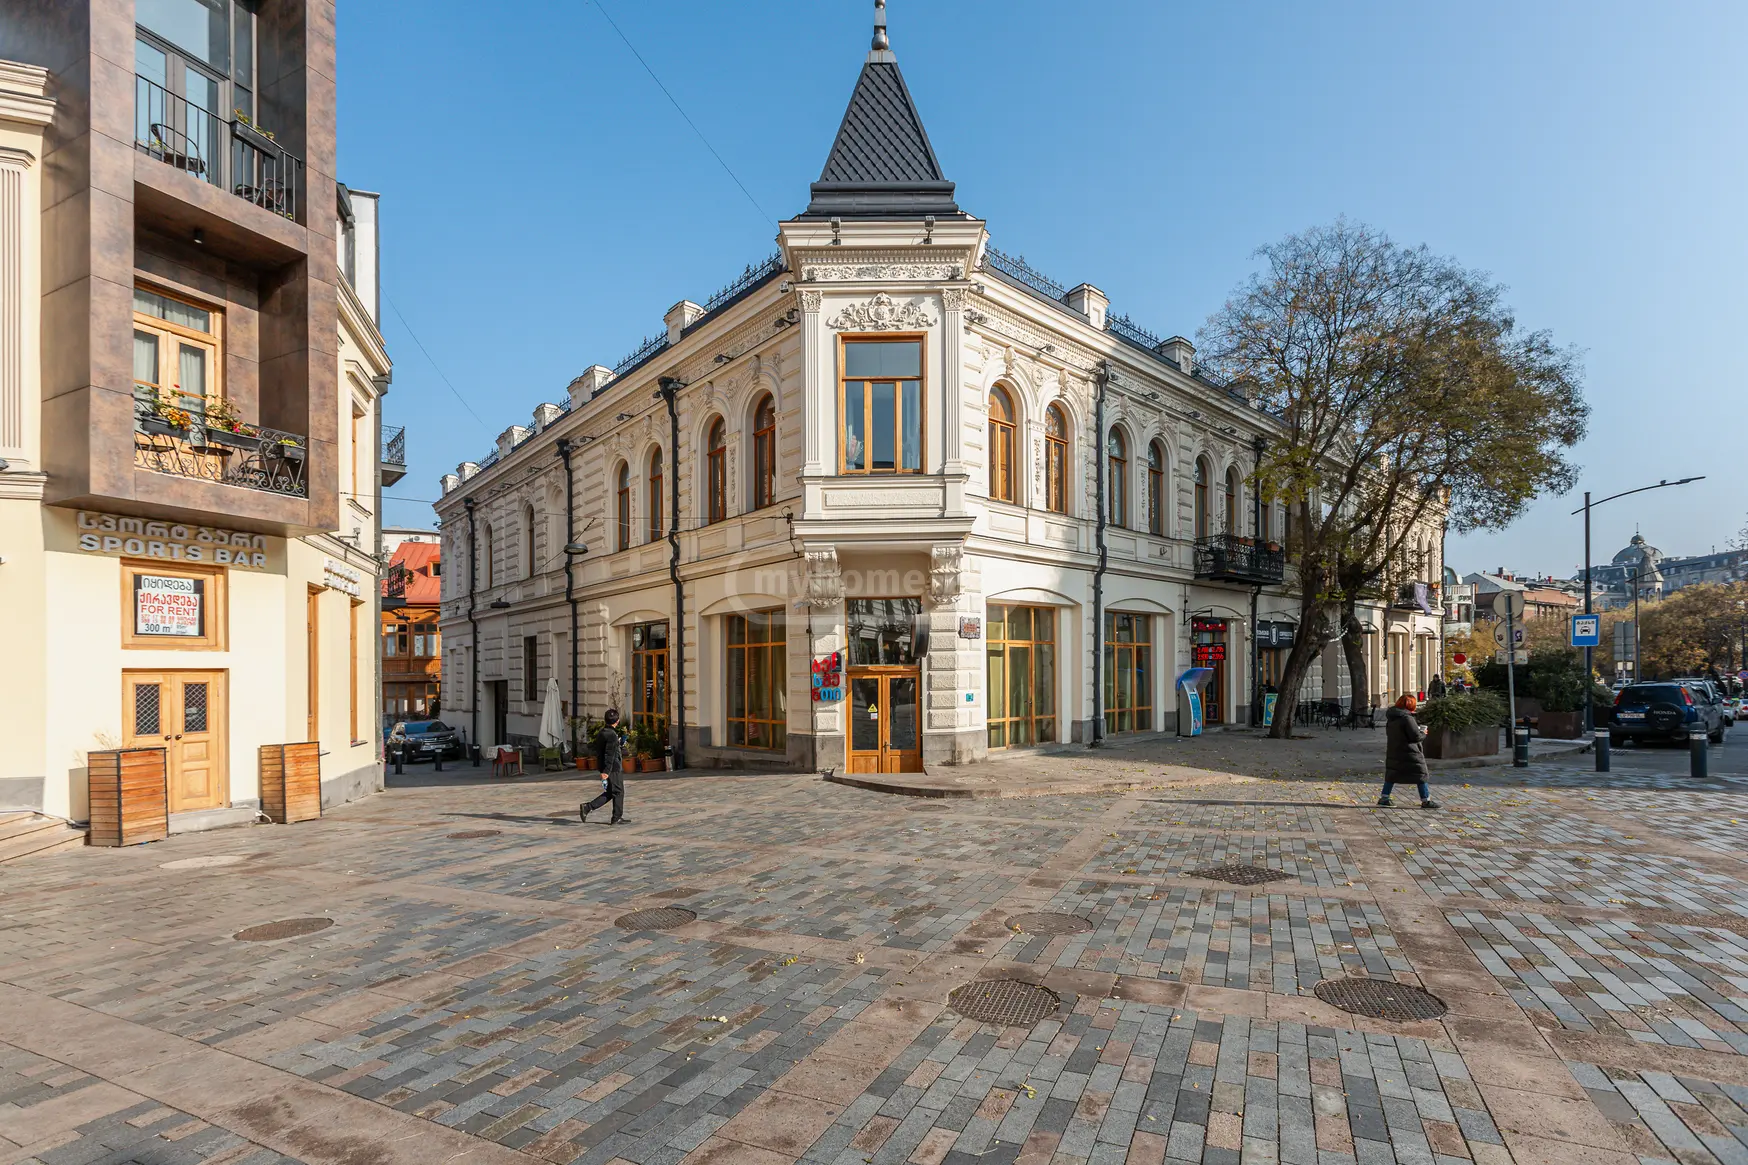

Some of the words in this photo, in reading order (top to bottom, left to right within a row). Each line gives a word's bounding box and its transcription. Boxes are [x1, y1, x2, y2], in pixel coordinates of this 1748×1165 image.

[79, 533, 203, 562] SPORTS
[214, 548, 267, 569] BAR
[143, 577, 193, 591] იყიდება
[139, 592, 198, 607] ქირავდება
[141, 604, 165, 615] FOR
[168, 606, 197, 616] RENT
[144, 623, 160, 632] 300
